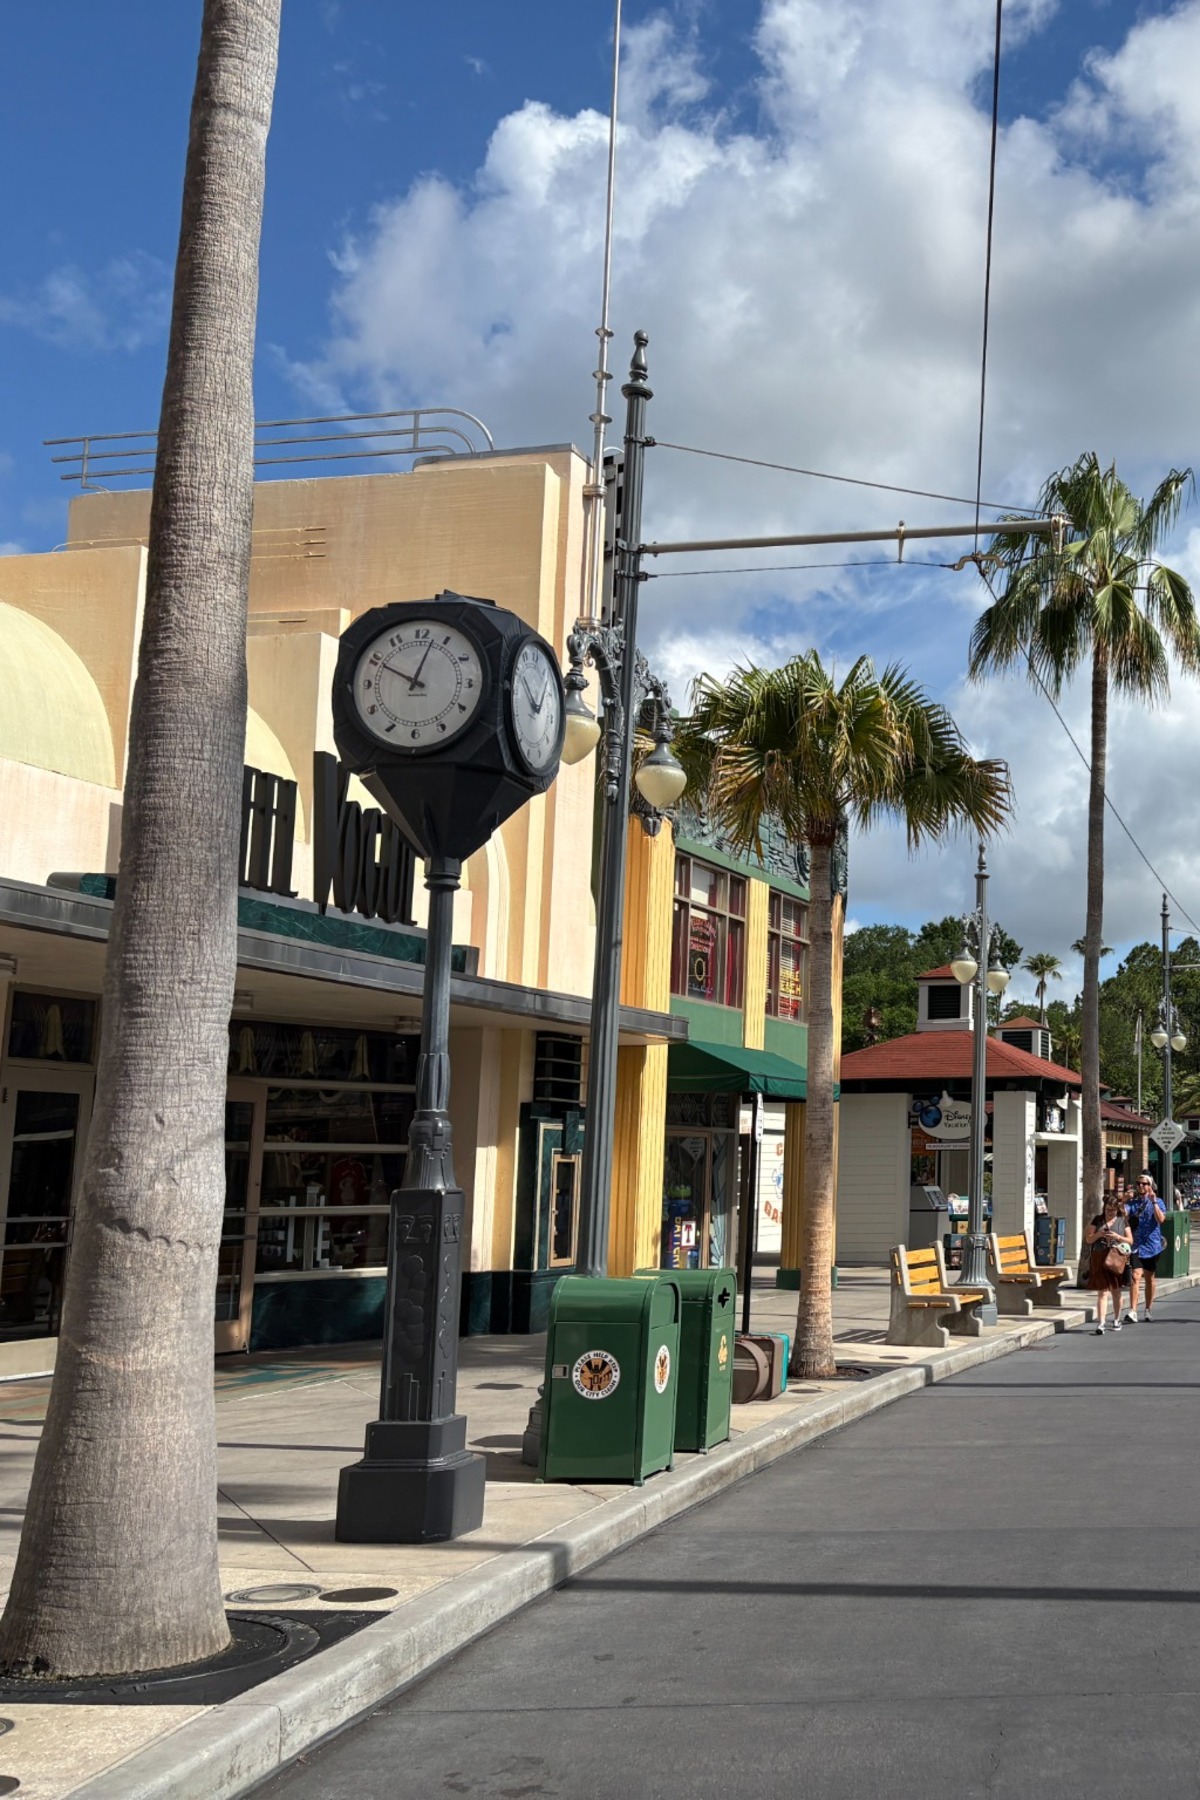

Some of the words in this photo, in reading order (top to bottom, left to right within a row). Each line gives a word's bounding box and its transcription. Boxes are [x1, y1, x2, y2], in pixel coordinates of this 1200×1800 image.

[415, 629, 430, 640] 12
[369, 651, 383, 667] 10
[458, 653, 470, 664] 2
[363, 679, 372, 690] 9
[464, 678, 473, 689] 3
[367, 704, 378, 715] 8
[457, 702, 467, 714] 4
[385, 721, 396, 733] 7
[436, 721, 446, 733] 5
[411, 729, 420, 740] 6
[942, 1110, 971, 1123] Disney
[575, 1353, 592, 1373] PLEASE
[593, 1352, 609, 1360] HELP
[608, 1358, 619, 1374] KEEP
[574, 1380, 585, 1393] OUR
[585, 1390, 600, 1398] CITY
[601, 1380, 617, 1396] CLEAN
